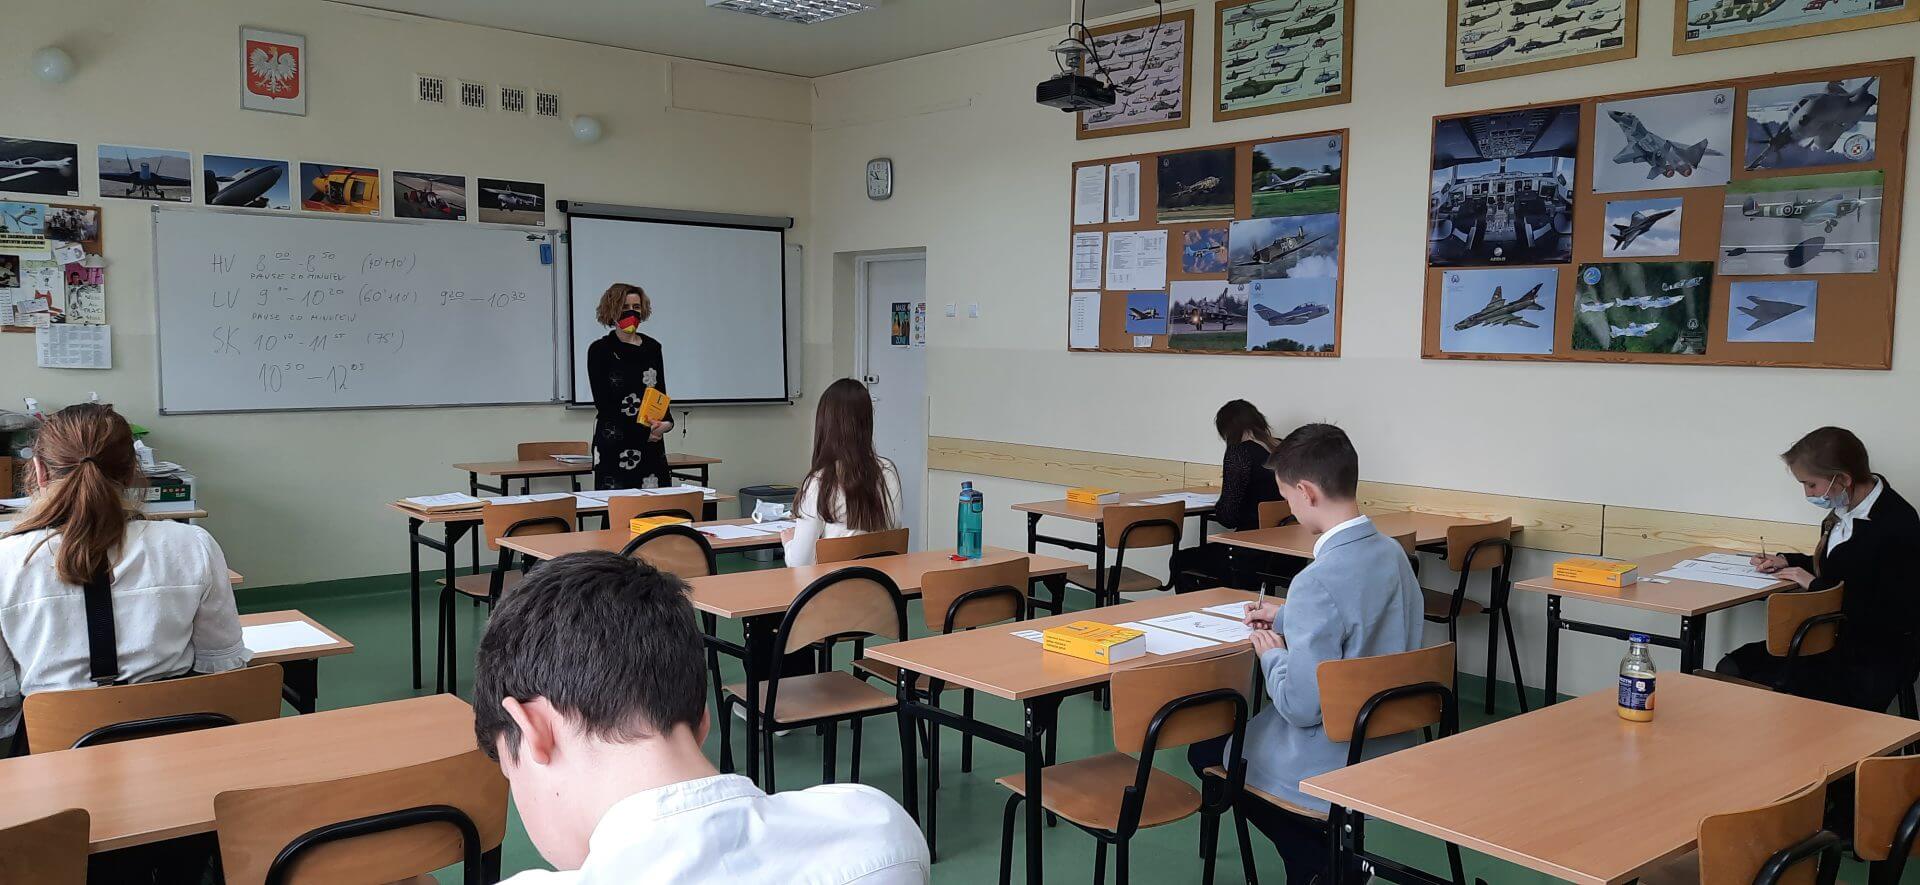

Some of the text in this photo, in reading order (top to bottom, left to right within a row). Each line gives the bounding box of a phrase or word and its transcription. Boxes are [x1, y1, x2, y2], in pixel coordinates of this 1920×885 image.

[210, 253, 236, 275] HV
[212, 287, 239, 309] LV
[212, 325, 241, 355] SK
